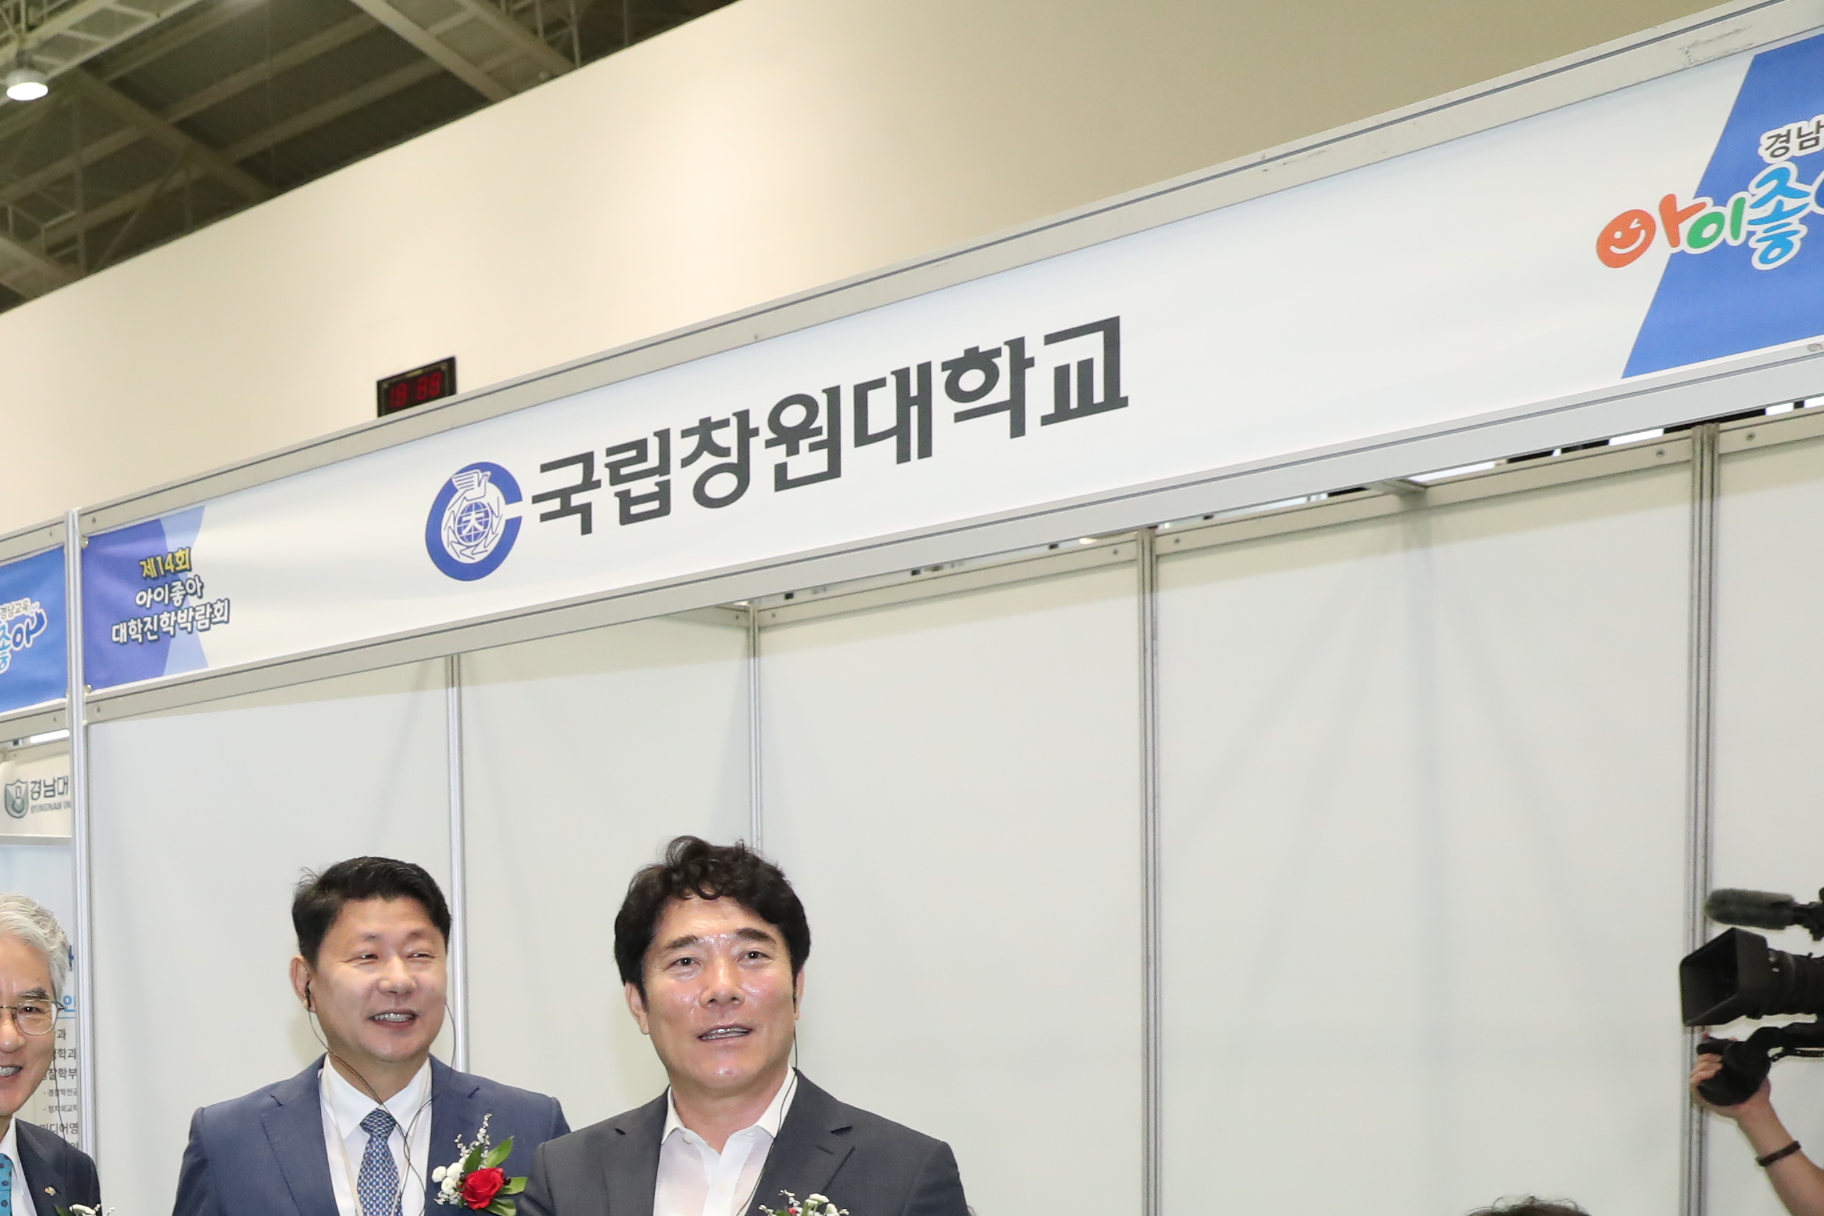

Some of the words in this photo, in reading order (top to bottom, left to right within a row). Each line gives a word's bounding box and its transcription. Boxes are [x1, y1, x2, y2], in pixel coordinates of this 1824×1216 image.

[531, 315, 1130, 536] 국립창원대학교
[139, 547, 193, 579] 제14회
[134, 574, 204, 609] 아이좋아
[111, 598, 231, 645] 대학진학박람회
[30, 776, 69, 801] 경남대
[54, 1047, 77, 1060] 학과
